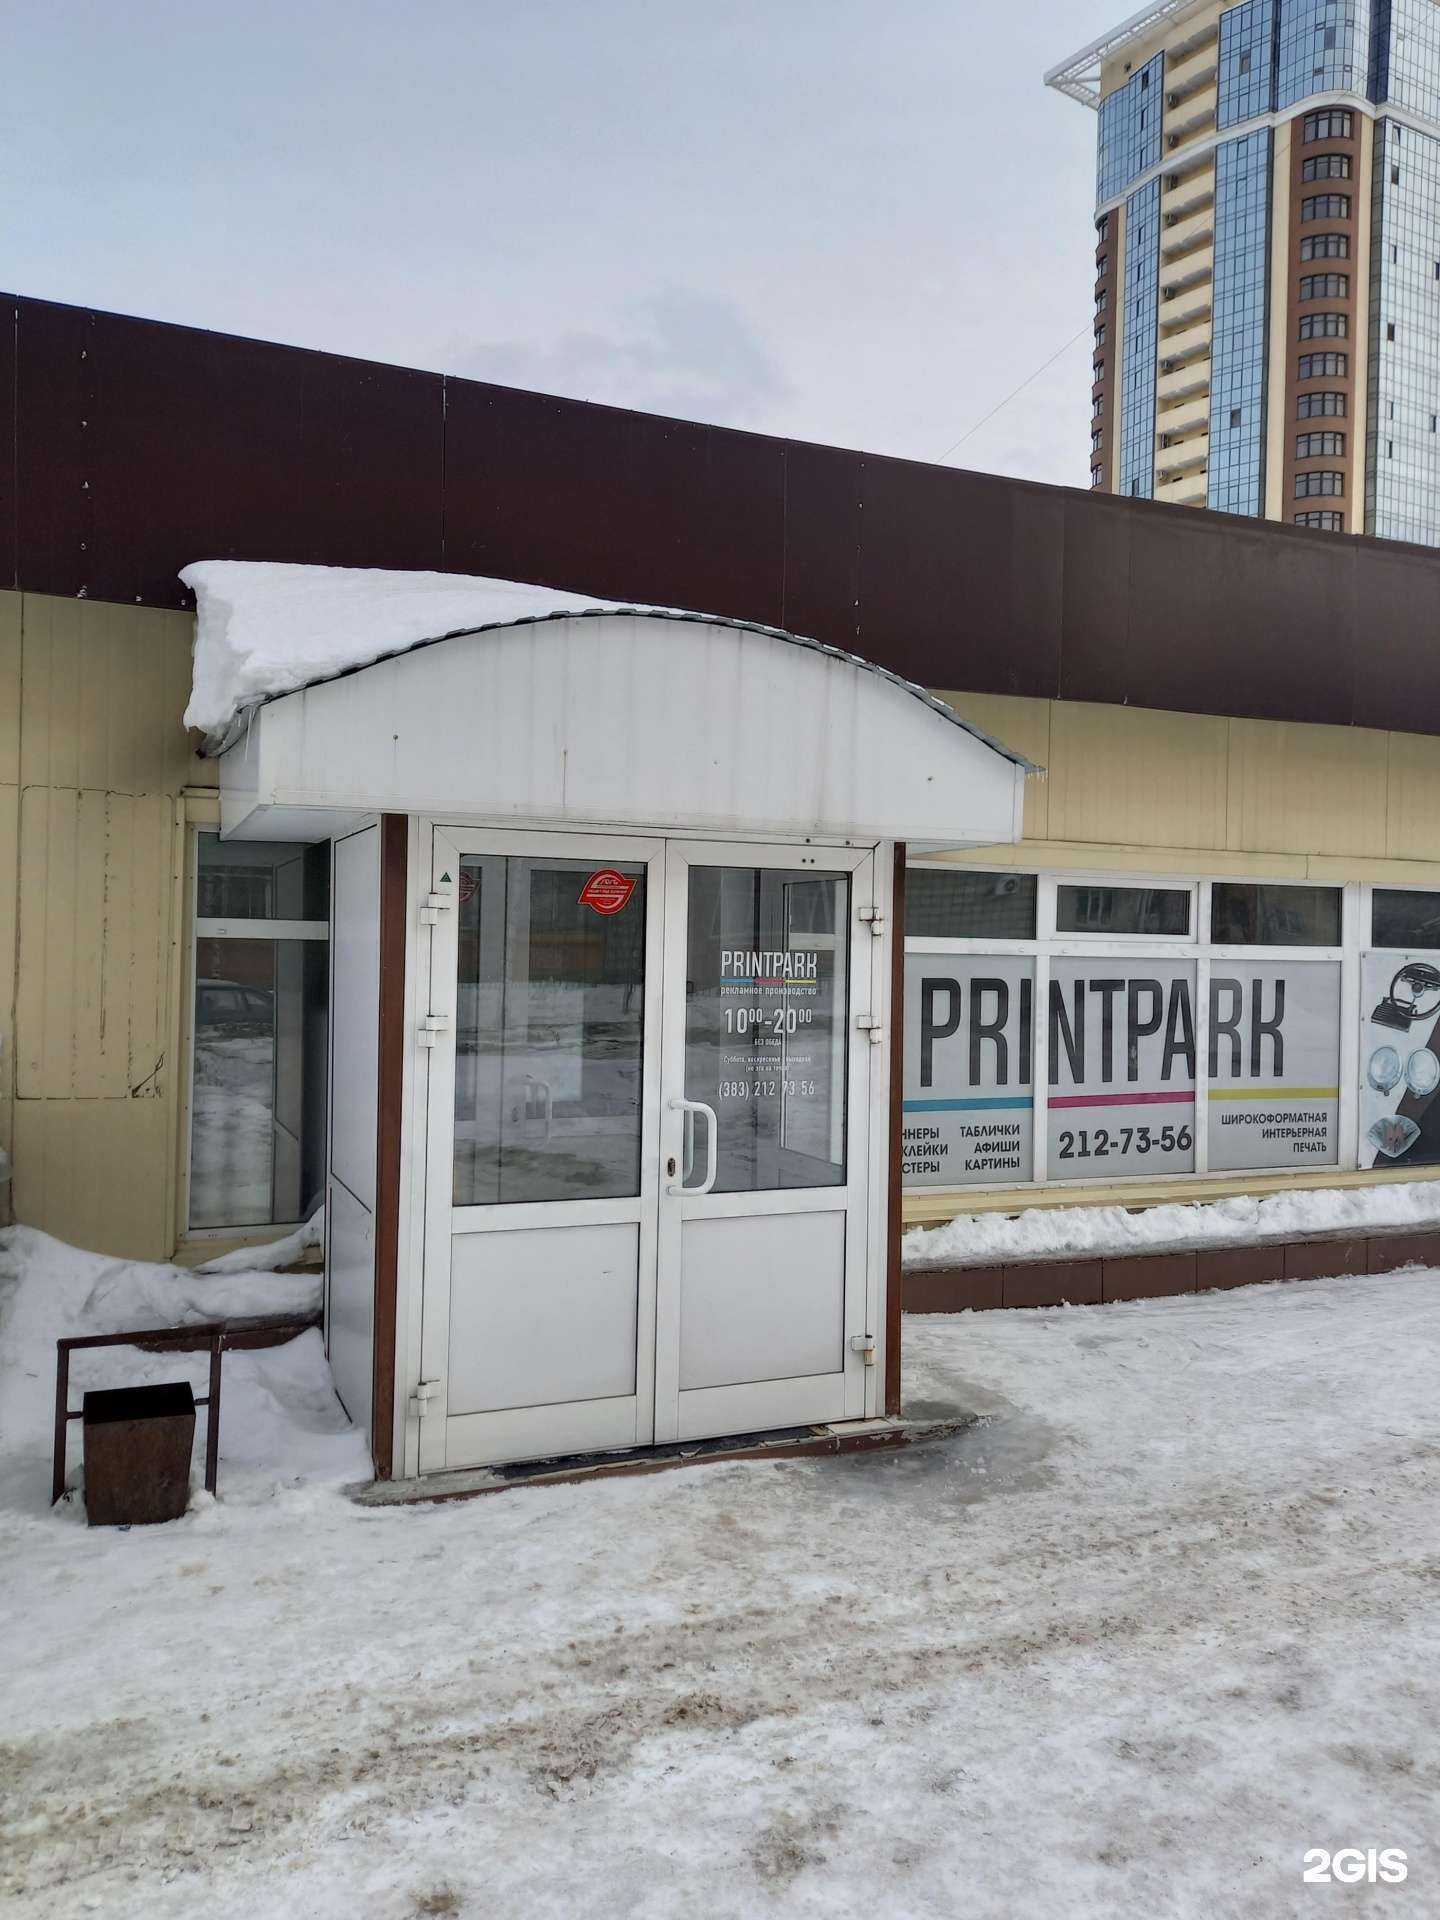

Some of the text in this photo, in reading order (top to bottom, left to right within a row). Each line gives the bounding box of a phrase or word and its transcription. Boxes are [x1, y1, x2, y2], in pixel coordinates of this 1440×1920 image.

[721, 951, 818, 978] PRINTPARK
[720, 986, 818, 997] рекламное производство
[920, 977, 1285, 1087] PRINTPARK
[719, 1080, 815, 1102] (383) 212 73 56
[1221, 1112, 1327, 1125] ШИРОКОФОРМАТНАЯ
[960, 1124, 1020, 1138] ТАБЛИЧКИ
[1262, 1127, 1327, 1139] ИНТЕРЬЕРНАЯ
[974, 1140, 1020, 1154] АФИШИ
[1058, 1125, 1193, 1159] 212-73-56
[1293, 1141, 1327, 1153] ПЕЧАТЬ
[965, 1156, 1020, 1171] КАРТИНЫ
